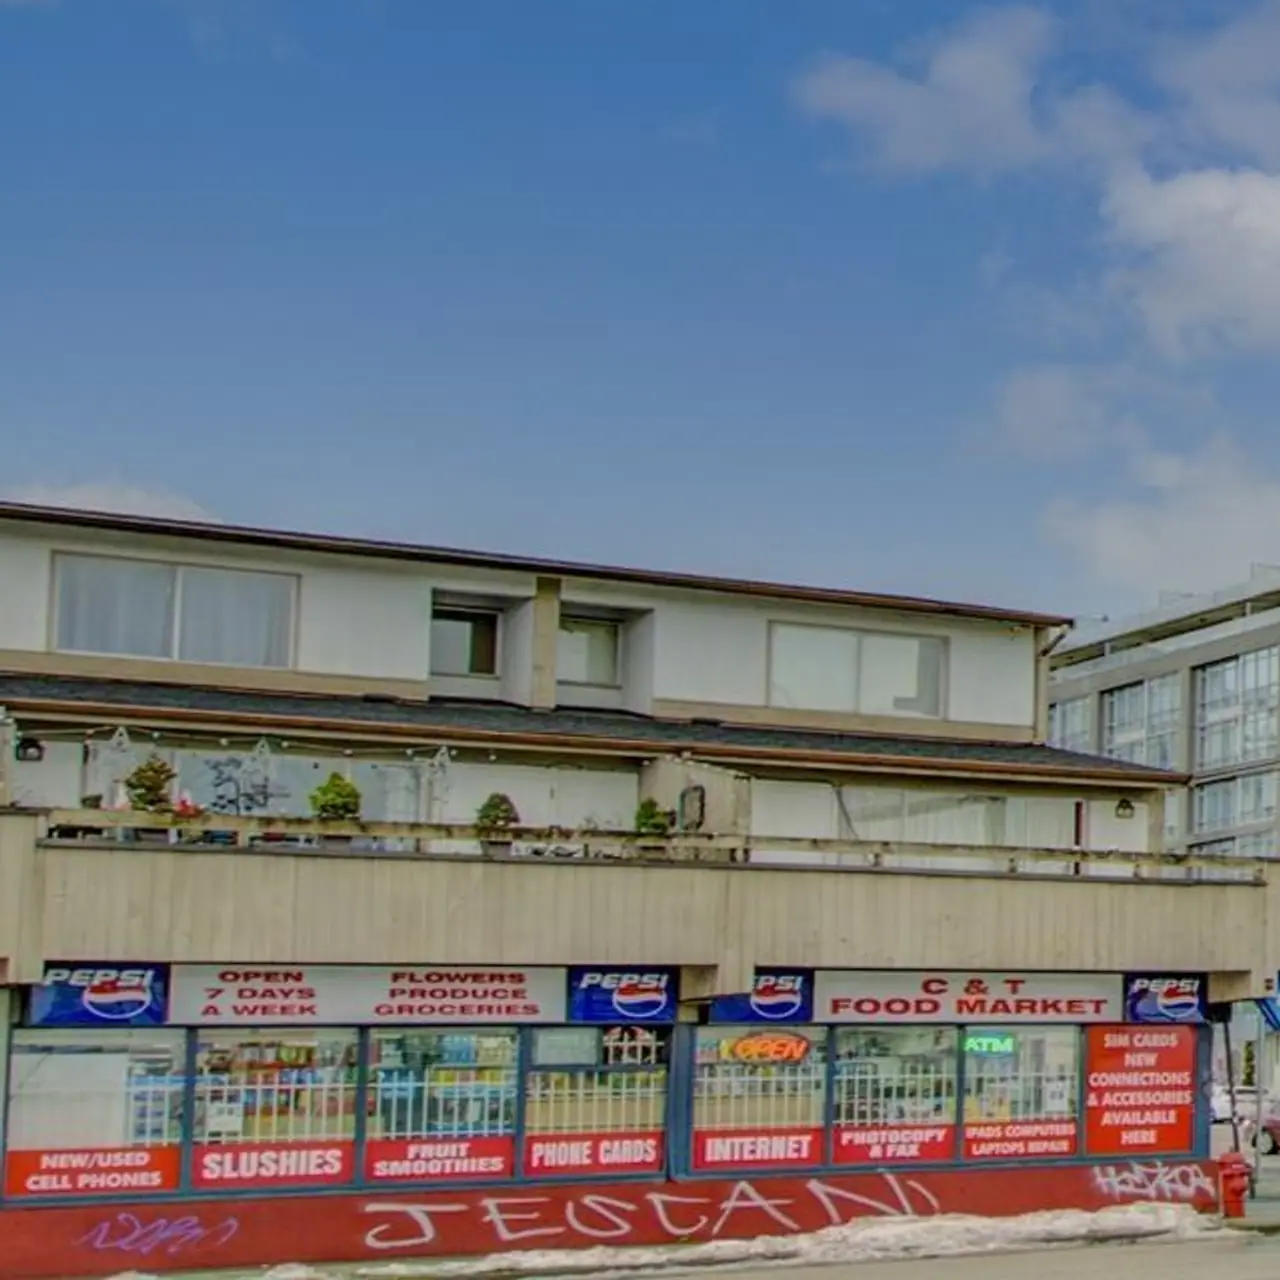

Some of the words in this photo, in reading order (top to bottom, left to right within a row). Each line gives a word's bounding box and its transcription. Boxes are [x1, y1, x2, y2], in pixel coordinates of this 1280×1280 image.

[43, 969, 154, 986] PEPSI
[218, 970, 304, 983] OPEN
[391, 972, 526, 984] FLOWERS
[579, 973, 670, 989] PEPSI
[921, 978, 949, 994] C
[963, 978, 990, 995] &
[1003, 979, 1026, 995] T
[1132, 977, 1200, 993] PEPSI
[204, 988, 224, 999] 7
[237, 988, 316, 1000] DAYS
[388, 988, 528, 999] PRODUCE
[201, 1004, 220, 1016] A
[231, 1004, 317, 1016] WEEK
[374, 1003, 540, 1016] GROCERIES
[830, 998, 942, 1015] FOOD
[956, 998, 1109, 1015] MARKET
[963, 1036, 1014, 1052] ATM
[1103, 1033, 1130, 1048] SIM
[1132, 1032, 1179, 1048] CARDS
[735, 1037, 808, 1060] OPEN
[1123, 1052, 1158, 1067] NEW
[1088, 1071, 1192, 1087] CONNECTIONS
[1101, 1090, 1193, 1106] ACCESSORIES
[1100, 1109, 1177, 1127] AVAILABLE
[841, 1128, 948, 1145] PHOTOCOPY
[1005, 1123, 1076, 1138] COMPUTERS
[1121, 1129, 1157, 1145] HERE
[407, 1143, 471, 1159] FRUIT
[531, 1141, 593, 1168] PHONE
[599, 1139, 656, 1164] CARDS
[704, 1135, 813, 1162] INTERNET
[886, 1143, 921, 1158] FAX
[971, 1140, 1025, 1156] LAPTOPS
[1027, 1140, 1071, 1154] REPAIR
[40, 1151, 151, 1169] NEW/USED
[202, 1148, 343, 1180] SLUSHIES
[374, 1157, 505, 1176] SMOOTHIES
[25, 1173, 73, 1191] CELL
[77, 1170, 163, 1189] PHONES
